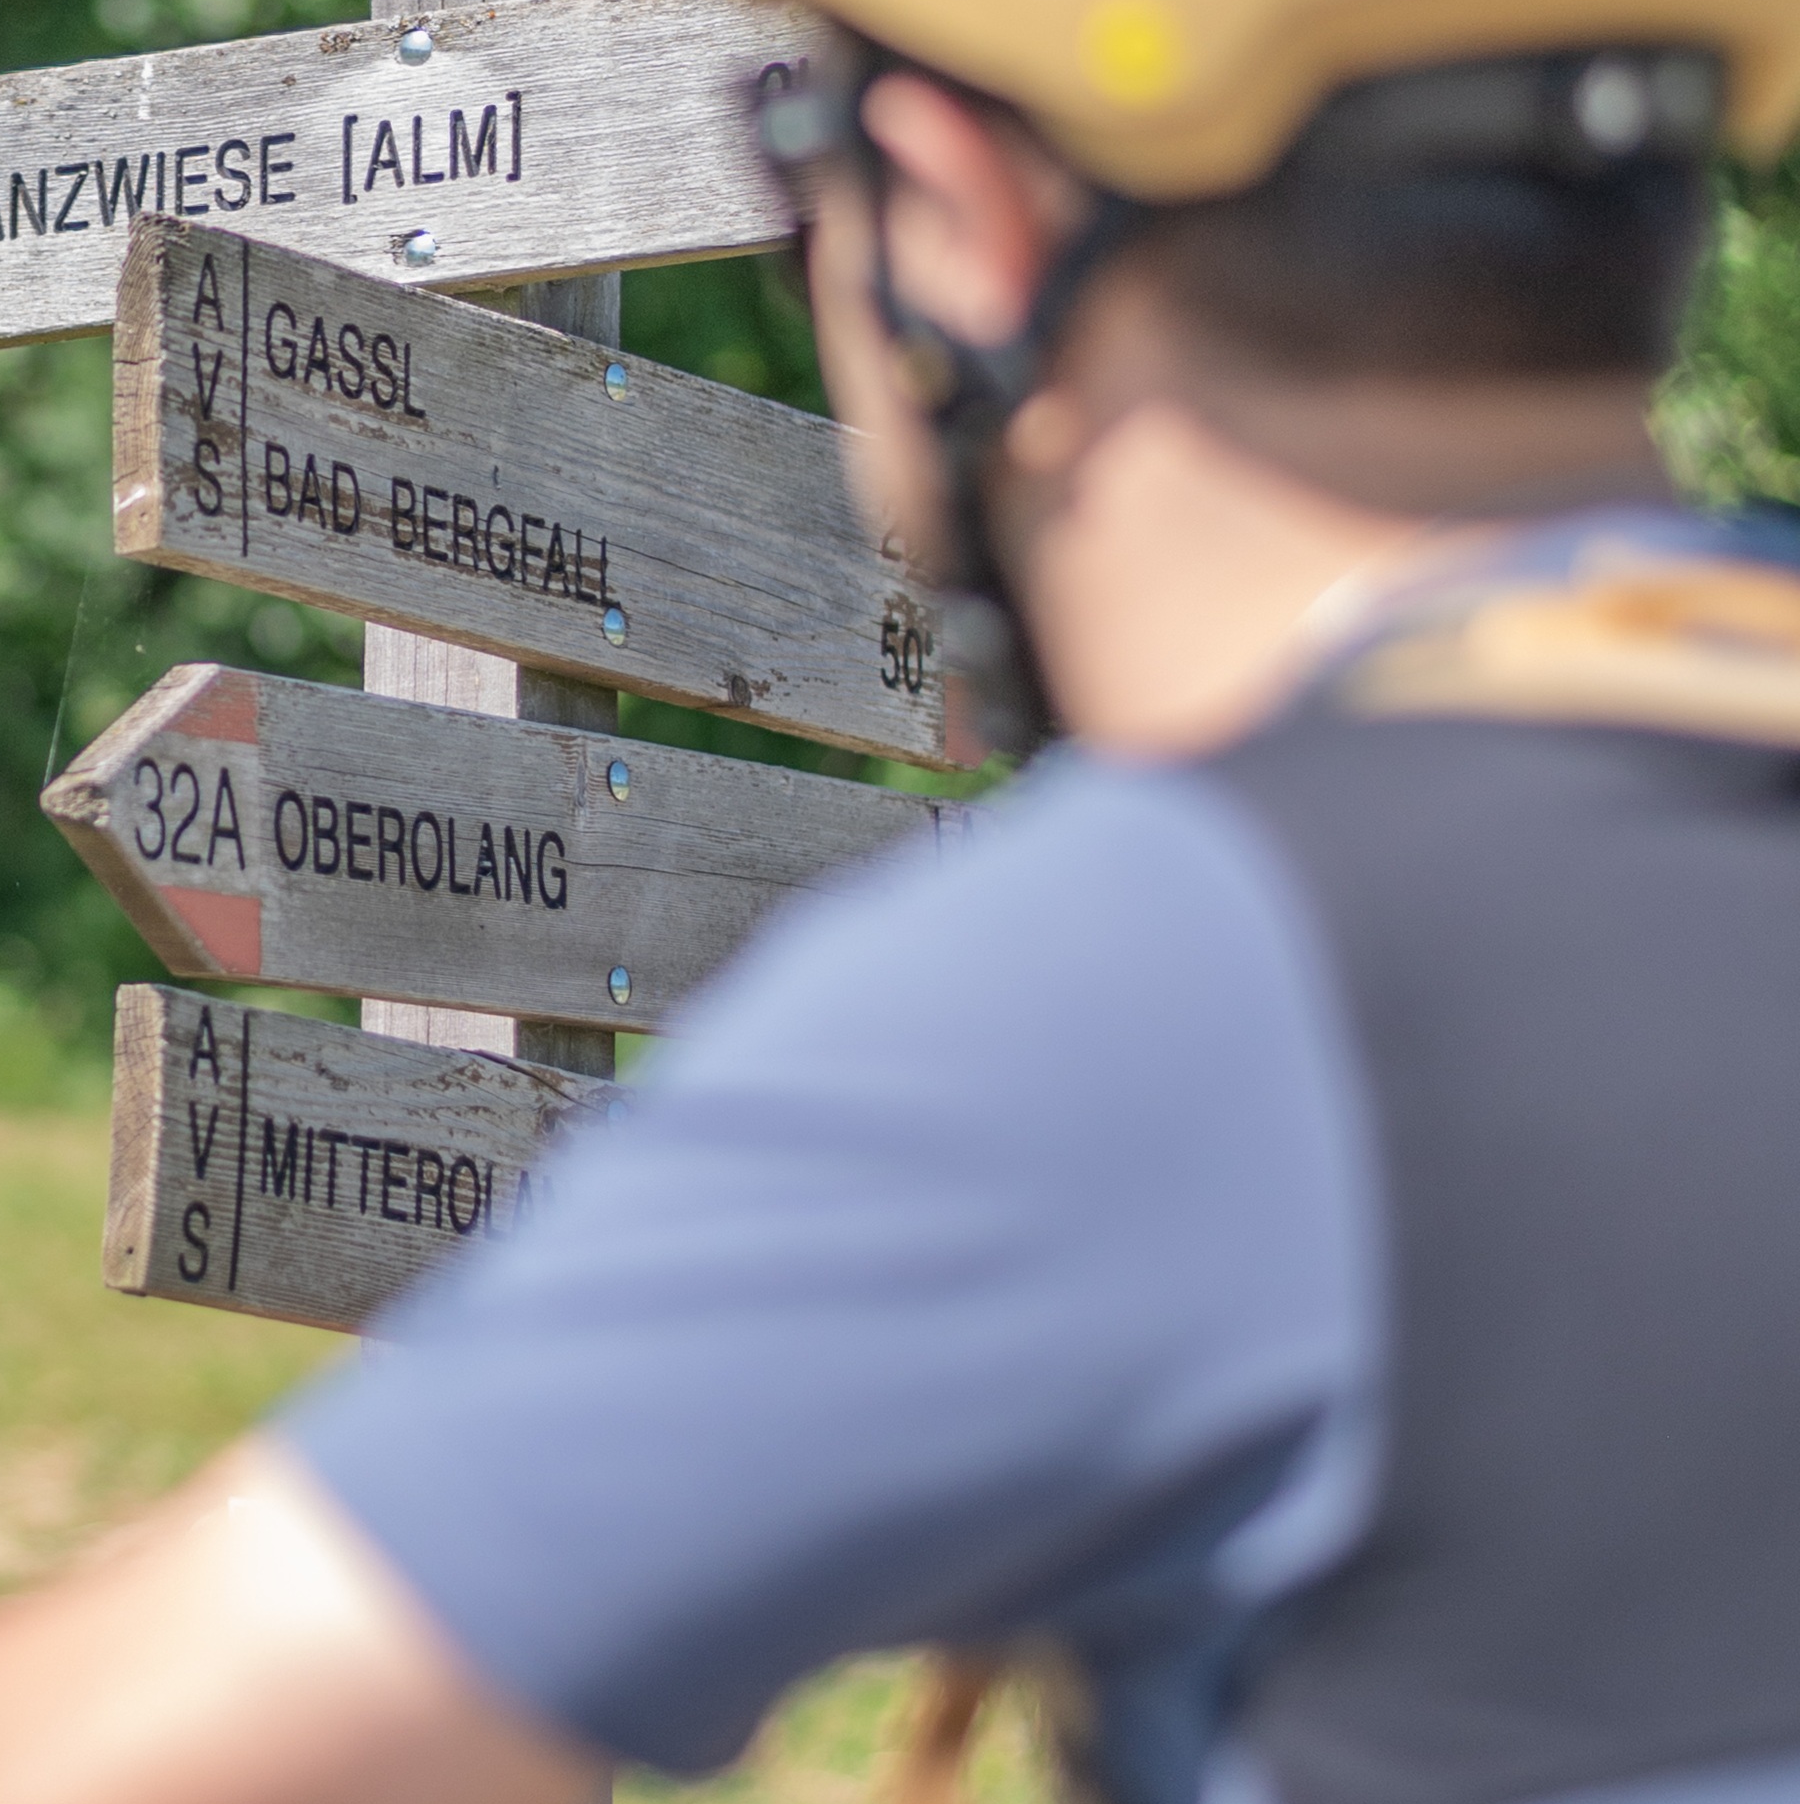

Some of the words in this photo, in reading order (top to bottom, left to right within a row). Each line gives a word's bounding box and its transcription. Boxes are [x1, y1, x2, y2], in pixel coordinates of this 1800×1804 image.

[342, 91, 523, 205] [ALM]
[263, 301, 427, 419] GASSL
[263, 440, 362, 537] BAD
[390, 477, 624, 607] BERGFALL
[132, 756, 247, 873] 32A
[272, 788, 569, 912] OBEROLANG
